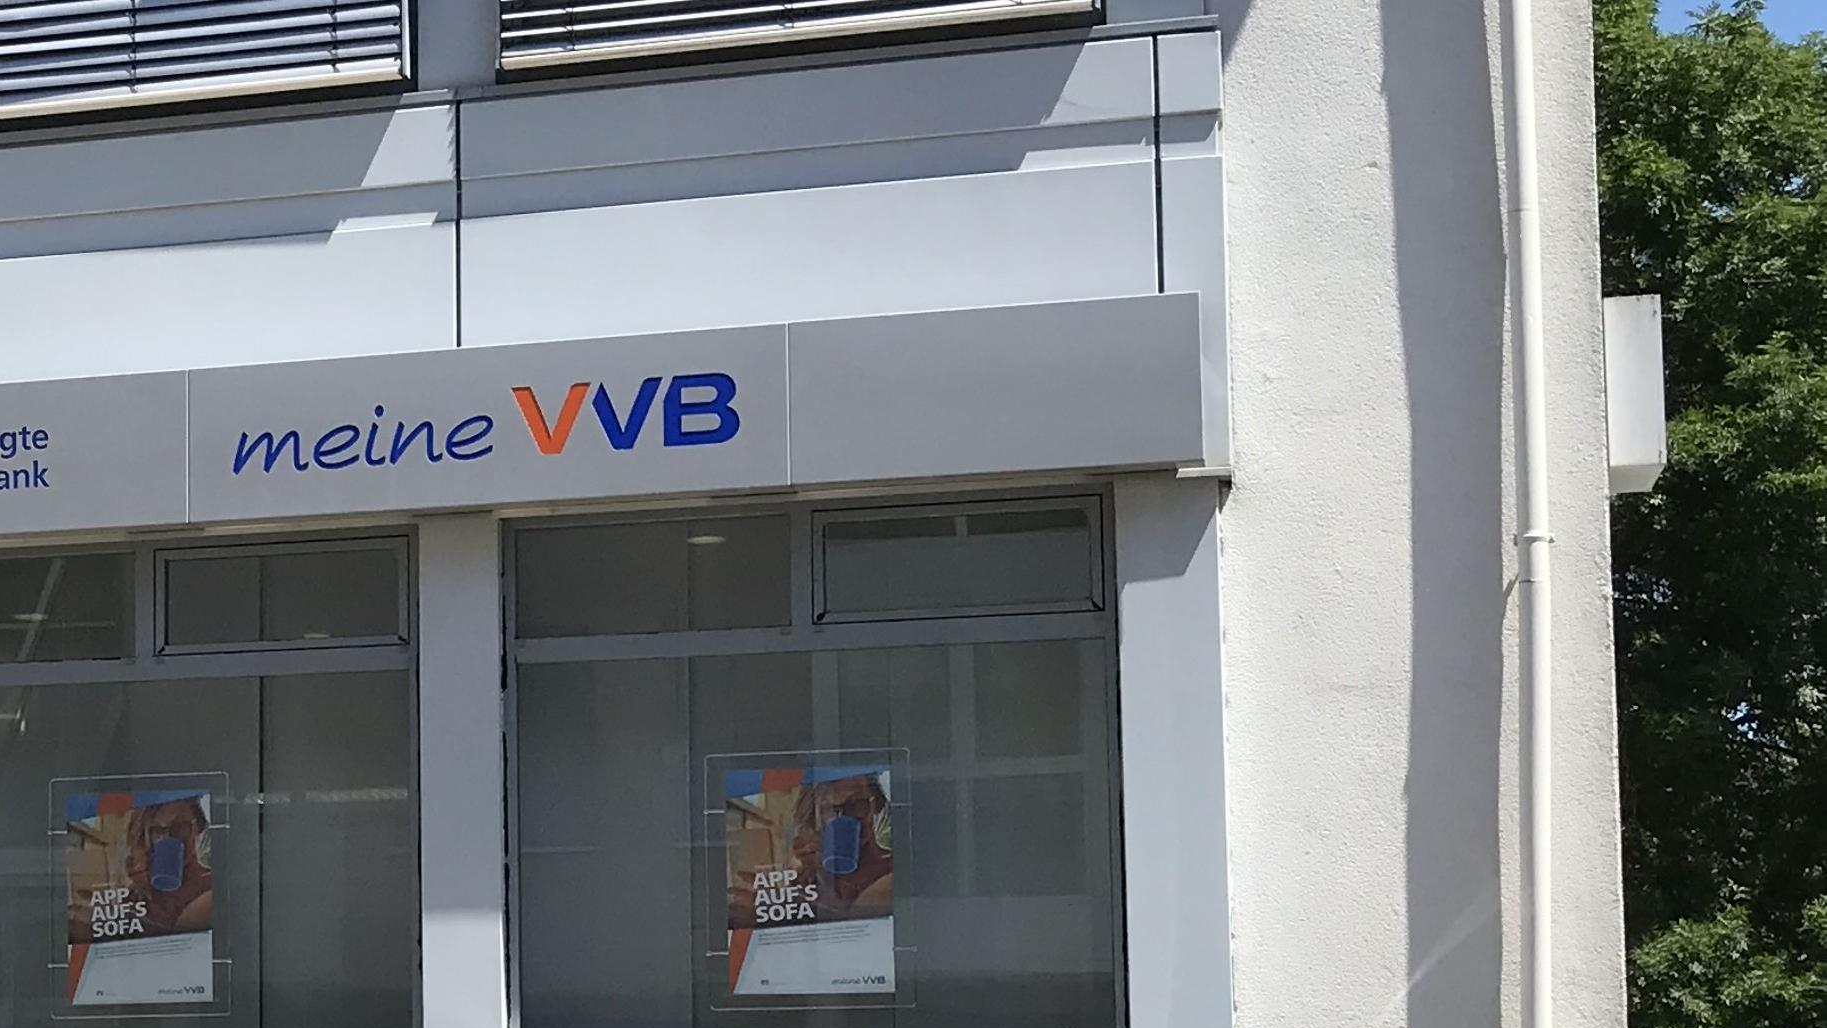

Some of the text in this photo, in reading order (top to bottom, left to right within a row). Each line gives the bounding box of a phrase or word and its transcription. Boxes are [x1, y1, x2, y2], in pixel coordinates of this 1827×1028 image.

[232, 372, 741, 475] meine VVB
[753, 869, 798, 889] APP
[90, 887, 130, 907] APP
[755, 902, 815, 923] SOFA
[92, 919, 144, 938] SOFA
